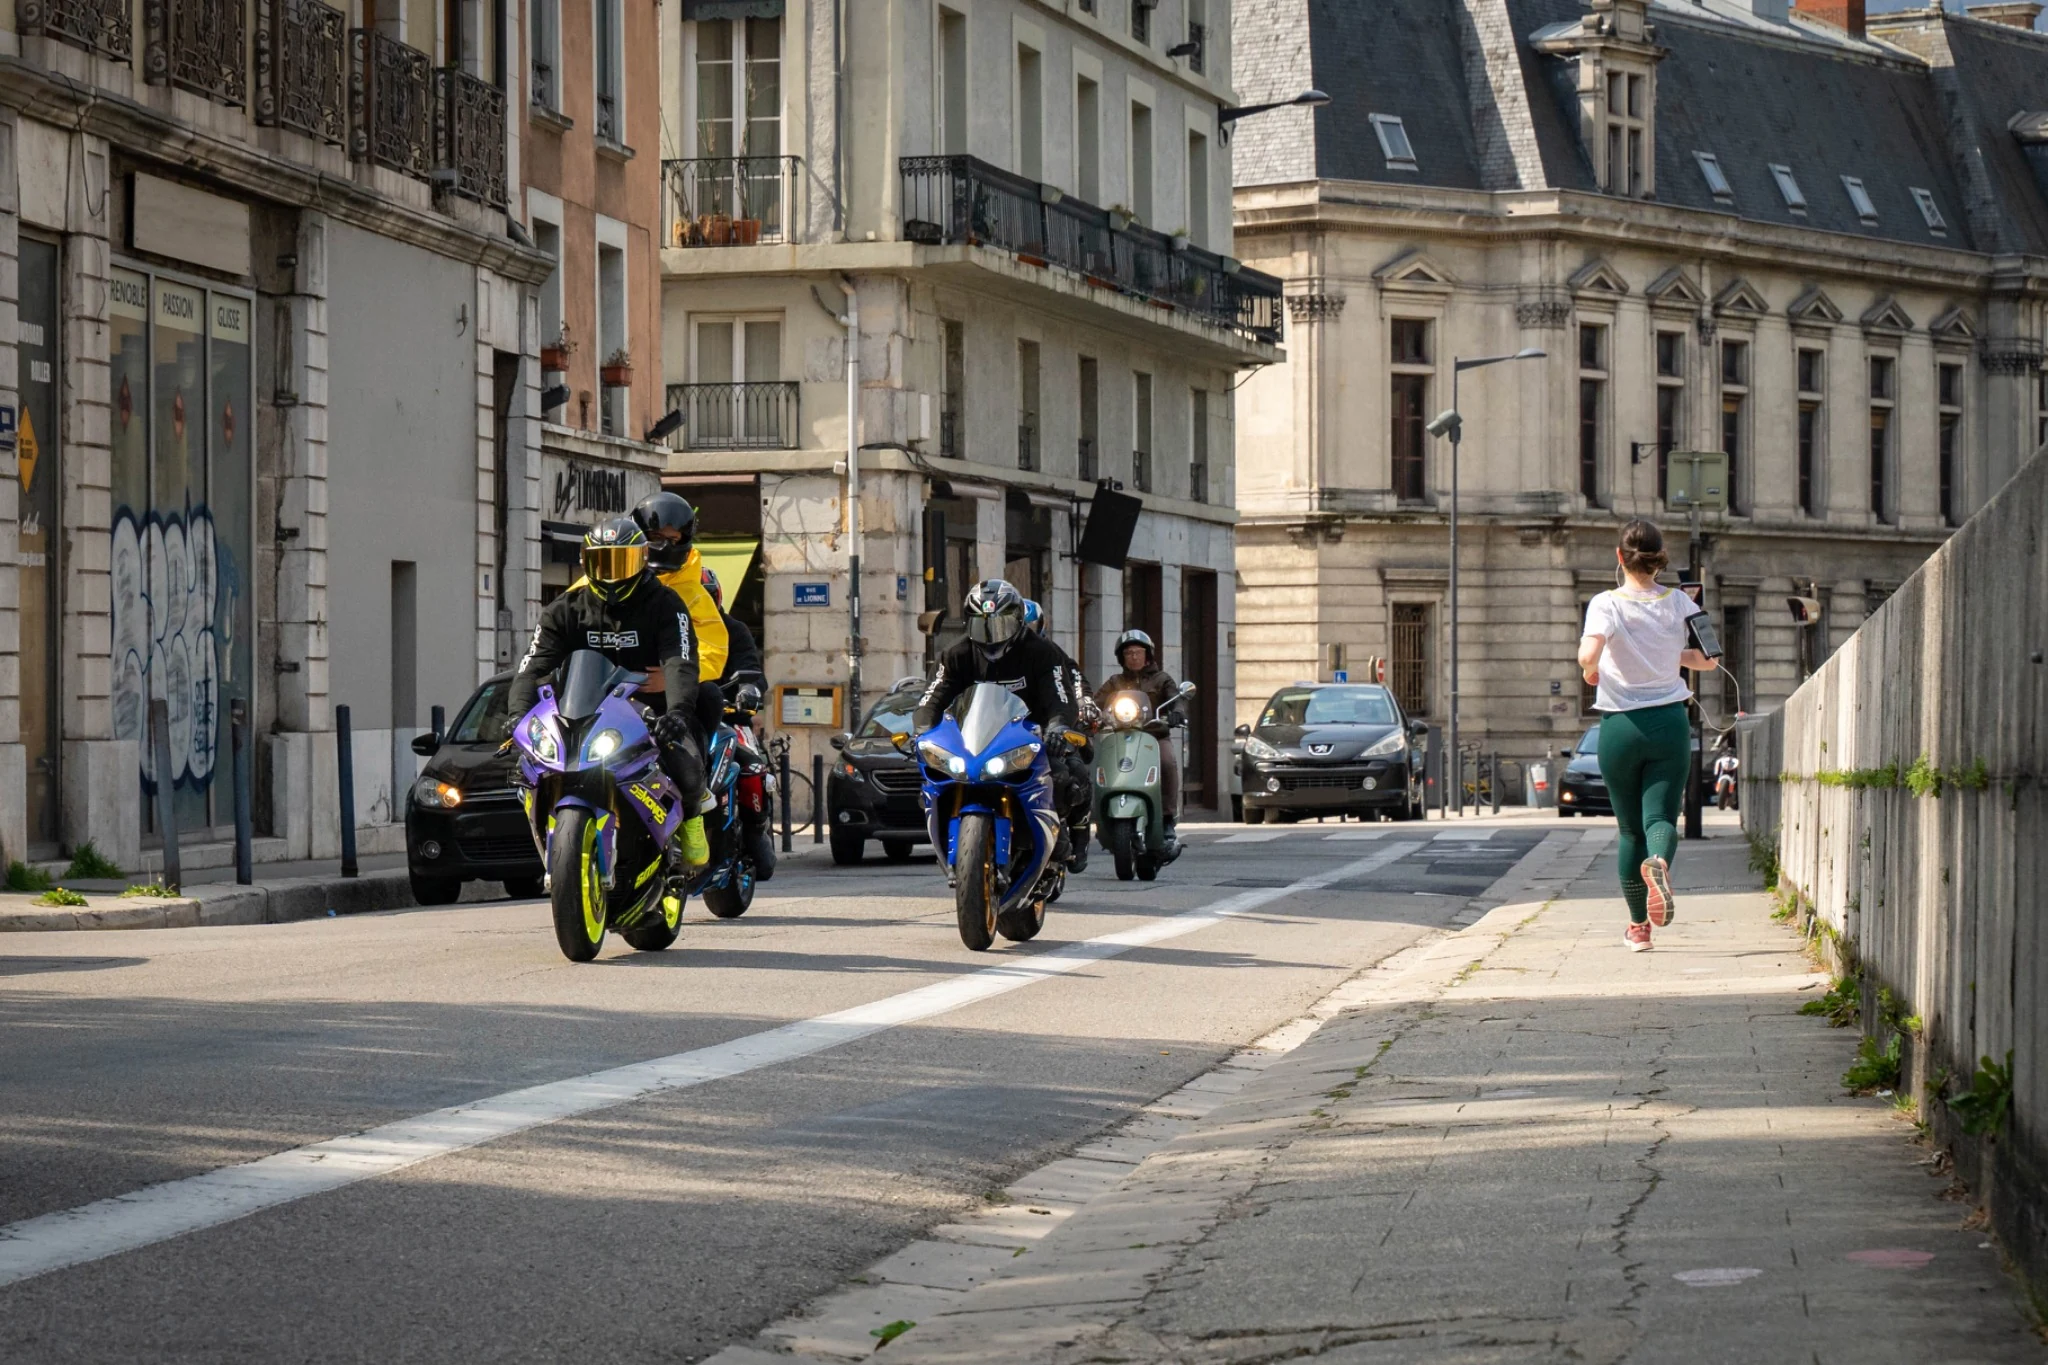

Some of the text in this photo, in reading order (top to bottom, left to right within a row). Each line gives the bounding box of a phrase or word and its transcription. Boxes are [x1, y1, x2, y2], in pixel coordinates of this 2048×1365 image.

[110, 280, 240, 330] RENOBLE PASSION GLISSE
